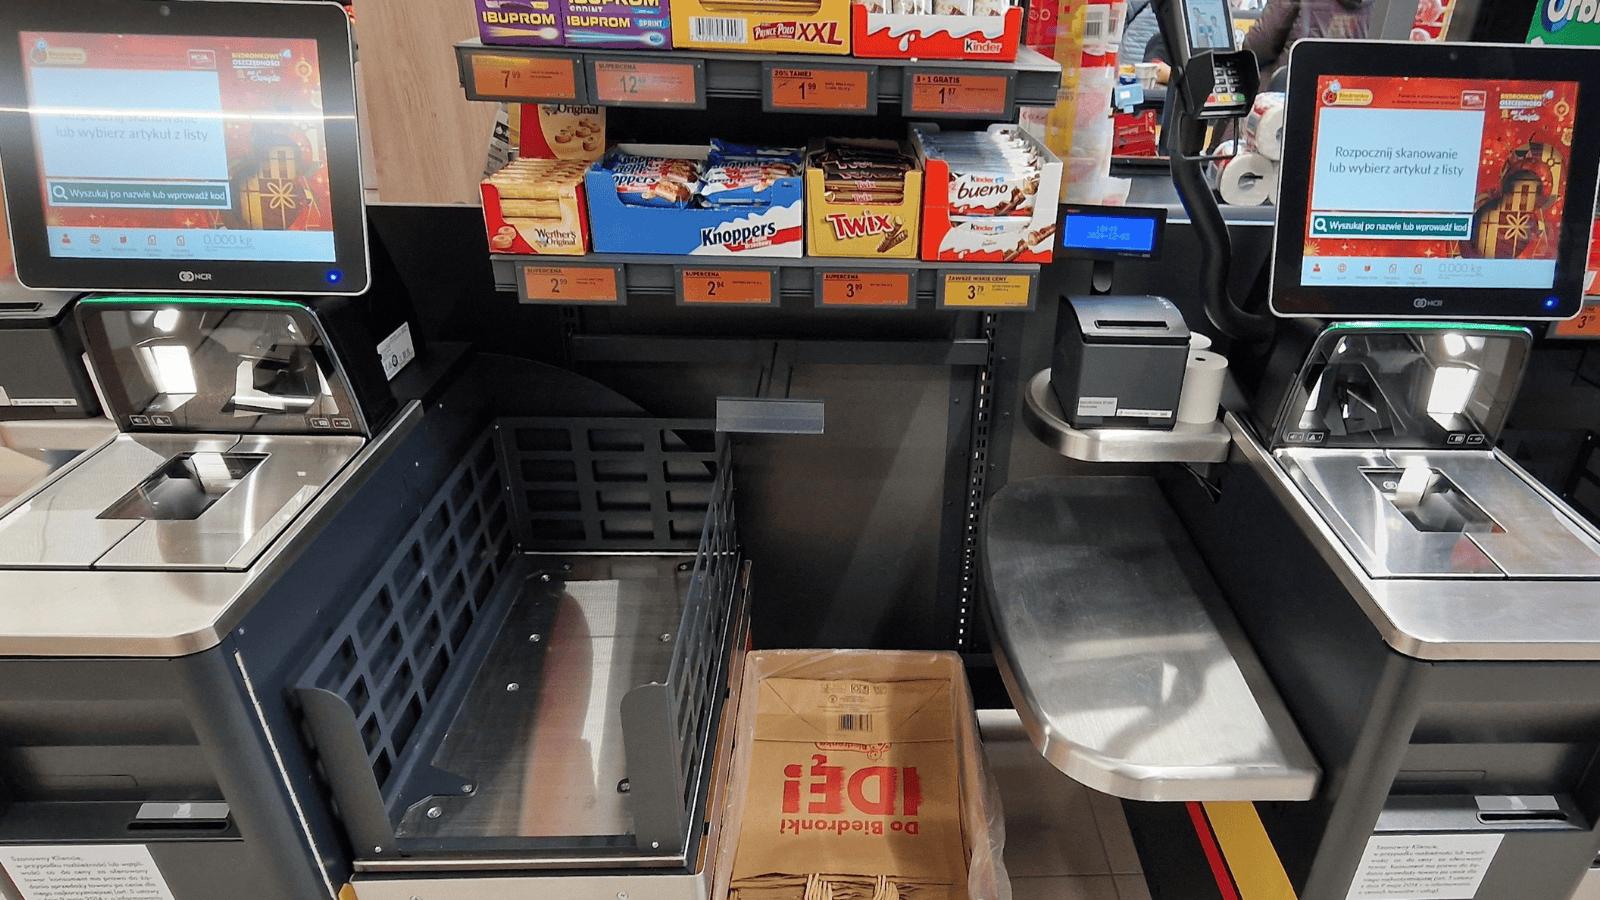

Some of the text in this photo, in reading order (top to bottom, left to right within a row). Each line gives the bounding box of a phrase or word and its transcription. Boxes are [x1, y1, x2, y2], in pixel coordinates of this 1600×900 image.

[482, 11, 556, 25] IBUPROM
[566, 15, 630, 28] IBUPROM
[797, 22, 843, 45] XXL
[933, 76, 960, 84] GRATIS
[55, 126, 208, 142] lub wybierz artykuł z listy
[1335, 146, 1458, 161] Rozpocznij skanowanie
[1329, 162, 1464, 177] lub wybierz artykuł z listy
[69, 188, 225, 201] Wyszukaj po nazwie lub wprowadź kod
[957, 182, 1008, 200] bueno
[826, 211, 893, 240] Twix
[1329, 220, 1364, 232] Wyszukaj
[1365, 223, 1376, 232] po
[1376, 222, 1402, 231] nazwie
[1402, 222, 1415, 231] lub
[1453, 223, 1467, 232] kod
[534, 229, 577, 240] Werther's
[702, 222, 776, 246] Knoppers
[546, 237, 576, 247] Original
[195, 273, 212, 281] NCR
[1427, 299, 1443, 307] NCR
[780, 819, 919, 836] Do Biedronki
